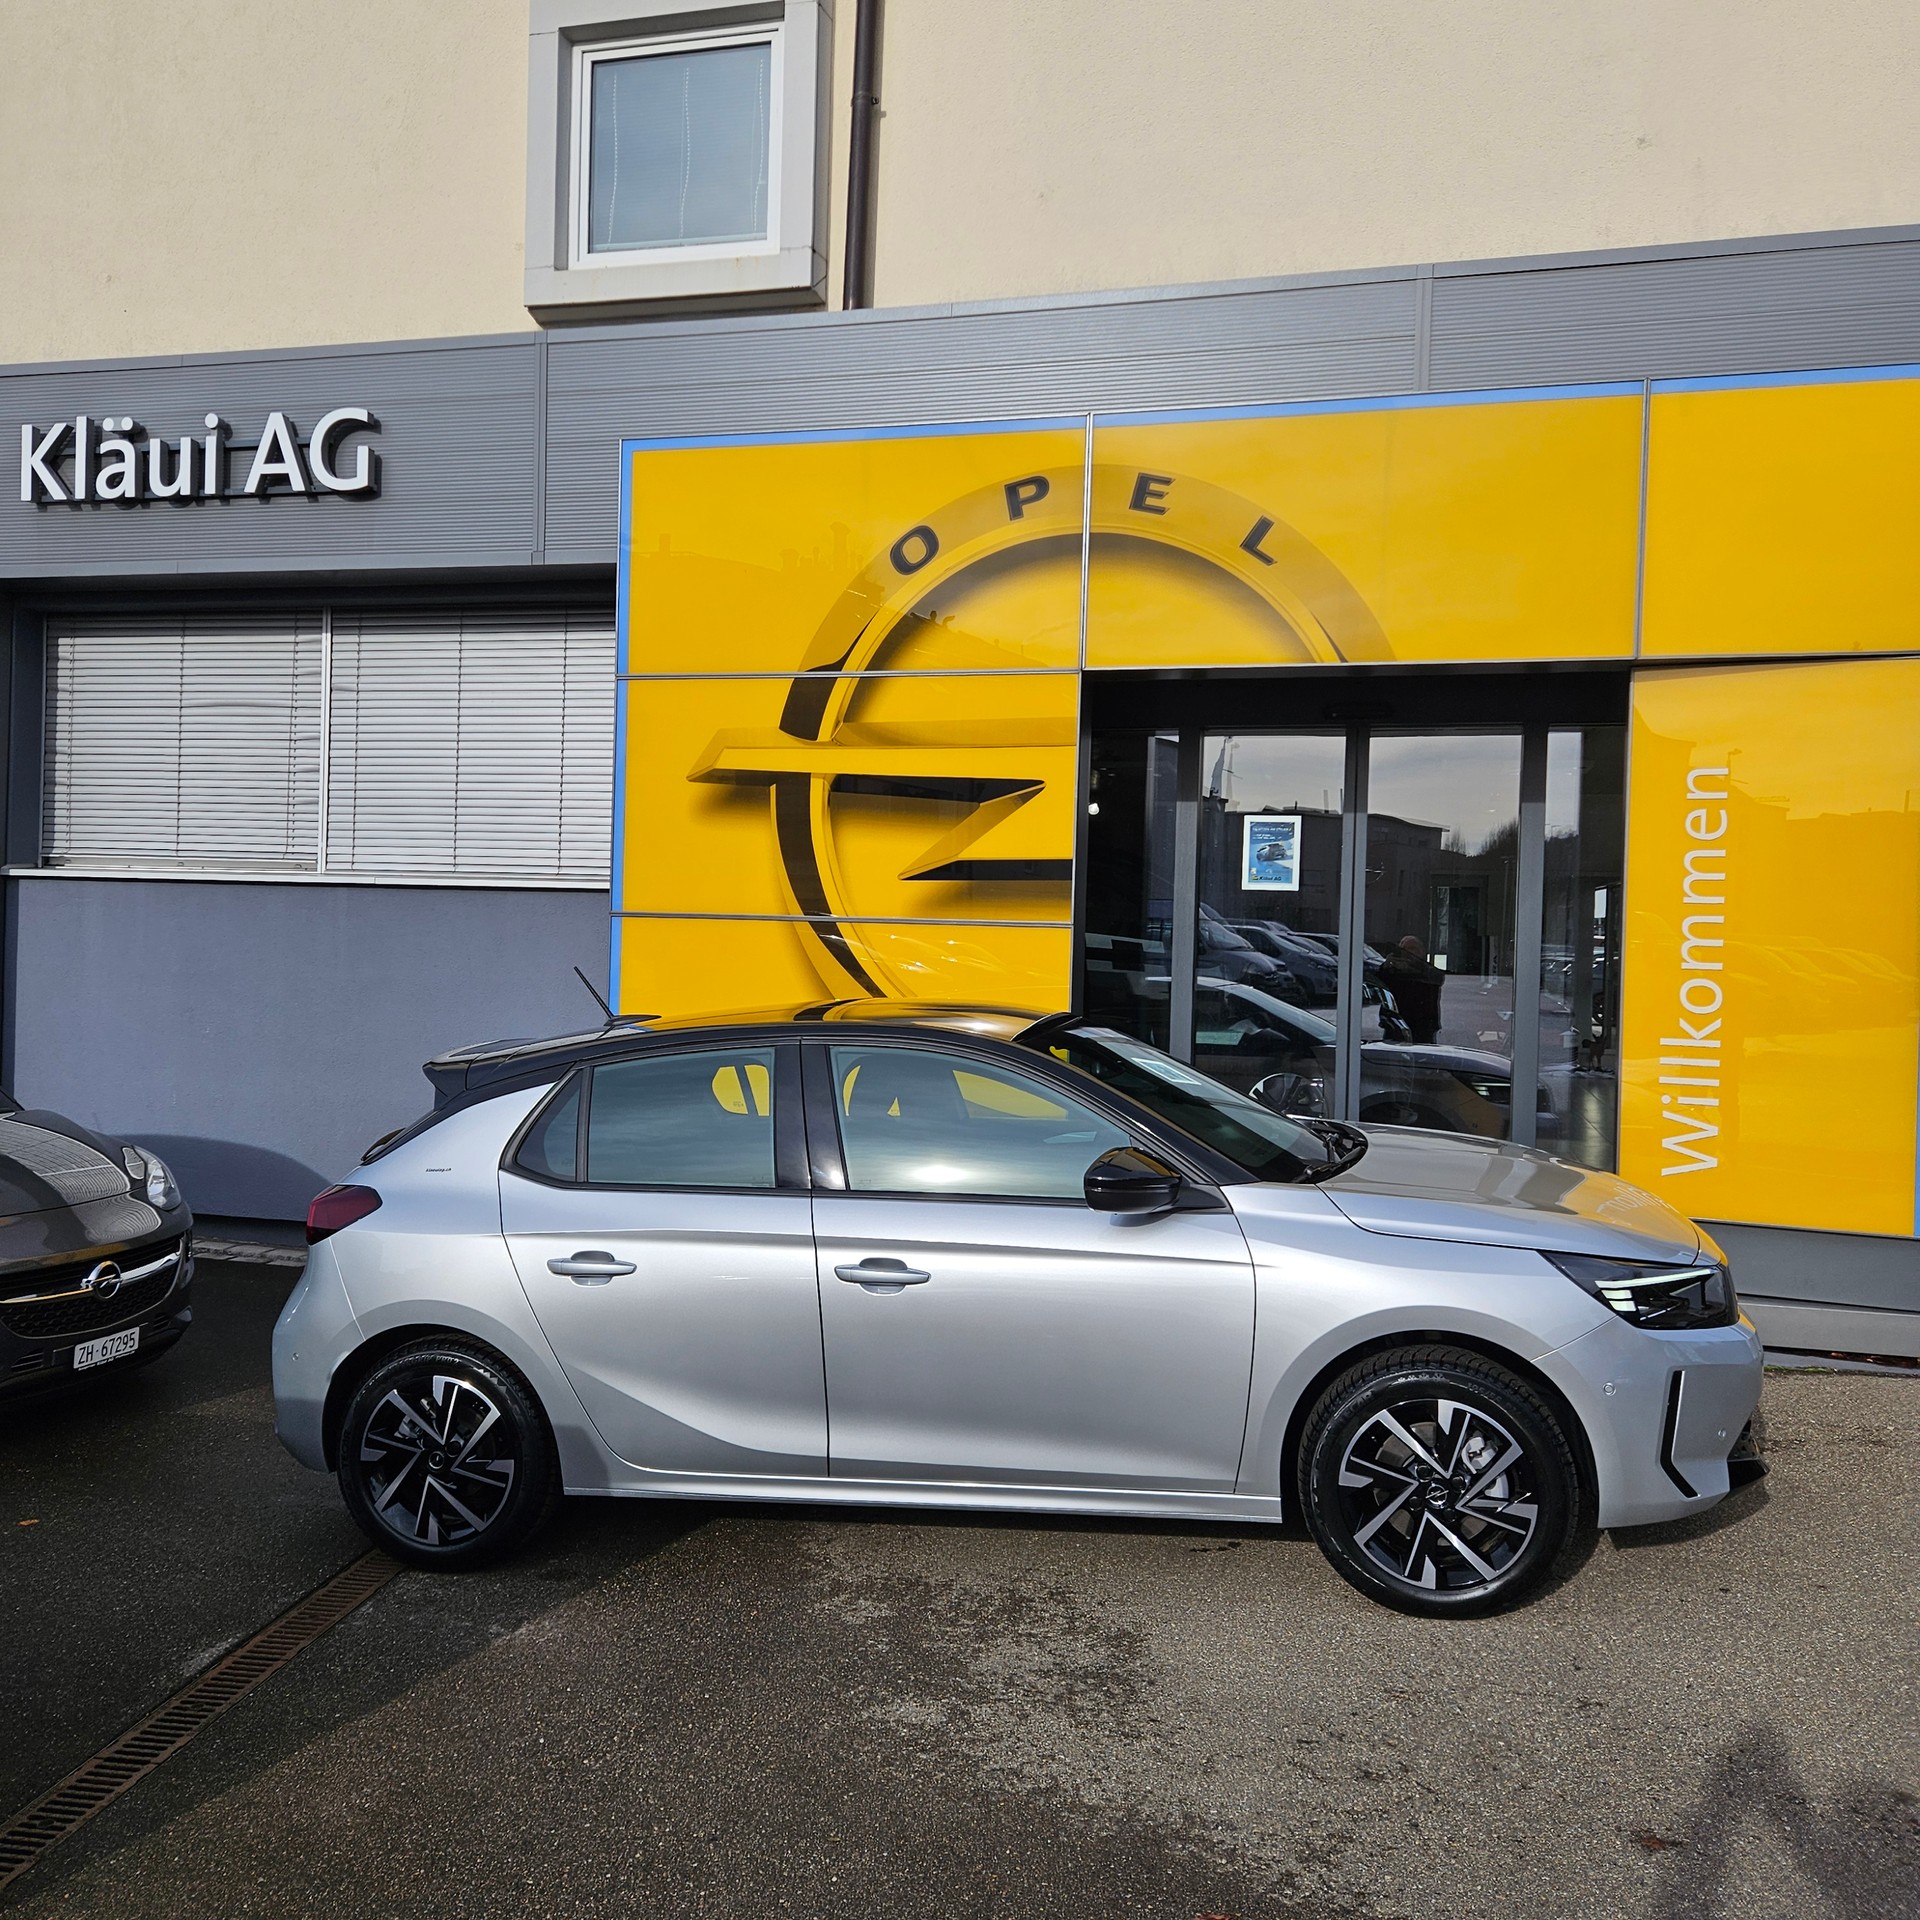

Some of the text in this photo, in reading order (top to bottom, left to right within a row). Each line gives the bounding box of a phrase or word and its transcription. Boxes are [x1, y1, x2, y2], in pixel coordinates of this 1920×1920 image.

[20, 407, 373, 501] Kläui AG
[889, 471, 1278, 576] OPEL
[1658, 767, 1730, 1177] Willkommen
